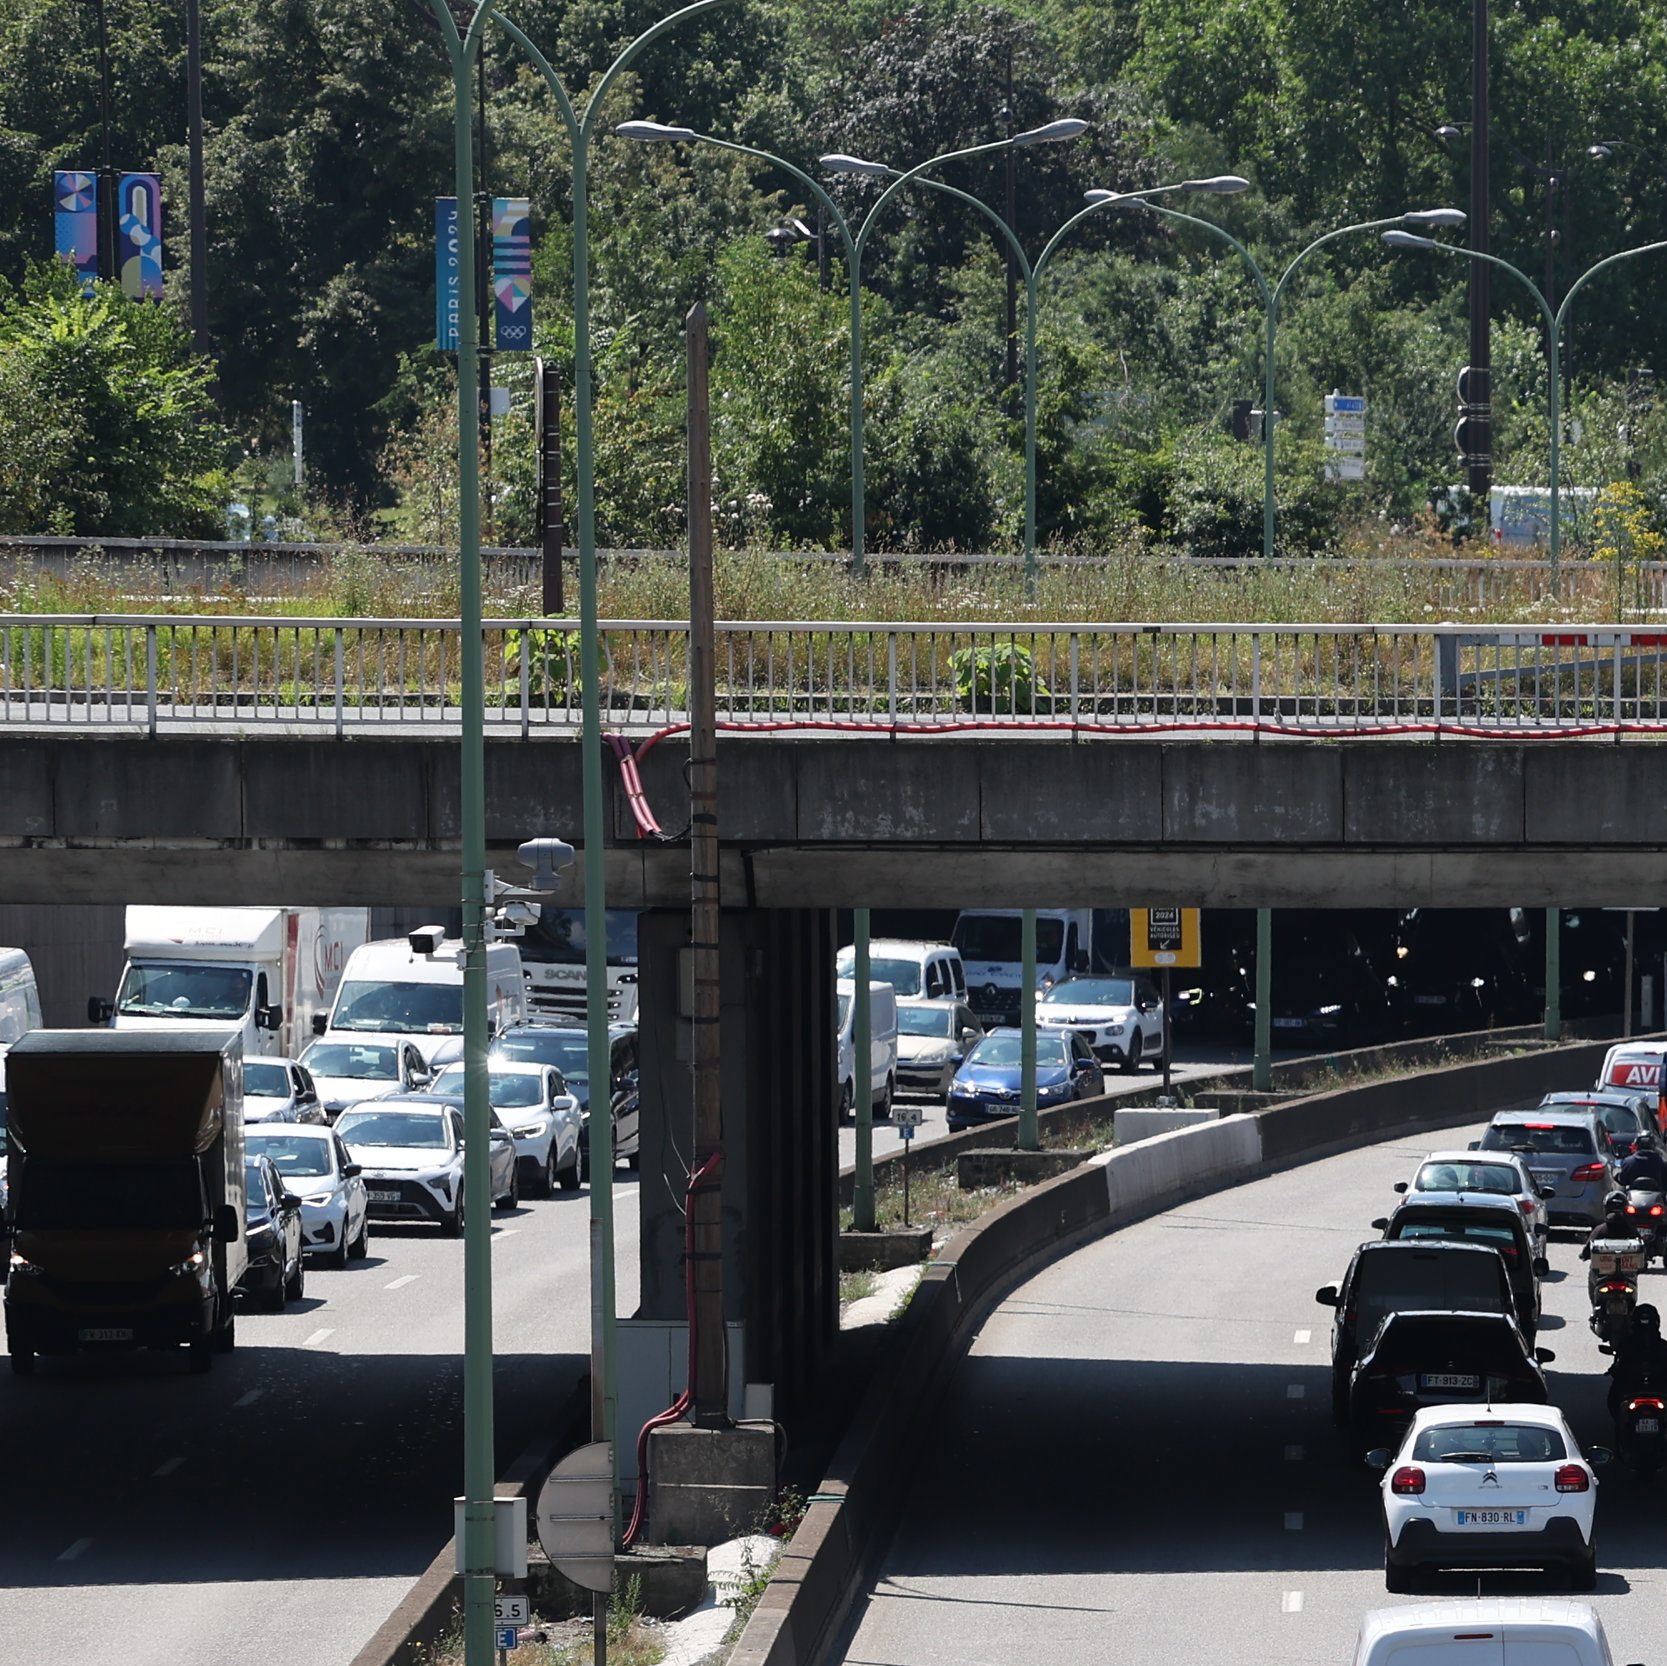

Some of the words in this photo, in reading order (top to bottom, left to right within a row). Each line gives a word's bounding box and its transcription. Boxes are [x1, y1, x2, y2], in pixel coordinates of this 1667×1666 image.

[1155, 911, 1175, 920] 2024
[544, 969, 588, 982] SCAN
[1427, 1376, 1474, 1387] FT-913-ZC
[1464, 1511, 1516, 1523] FN-830-RL
